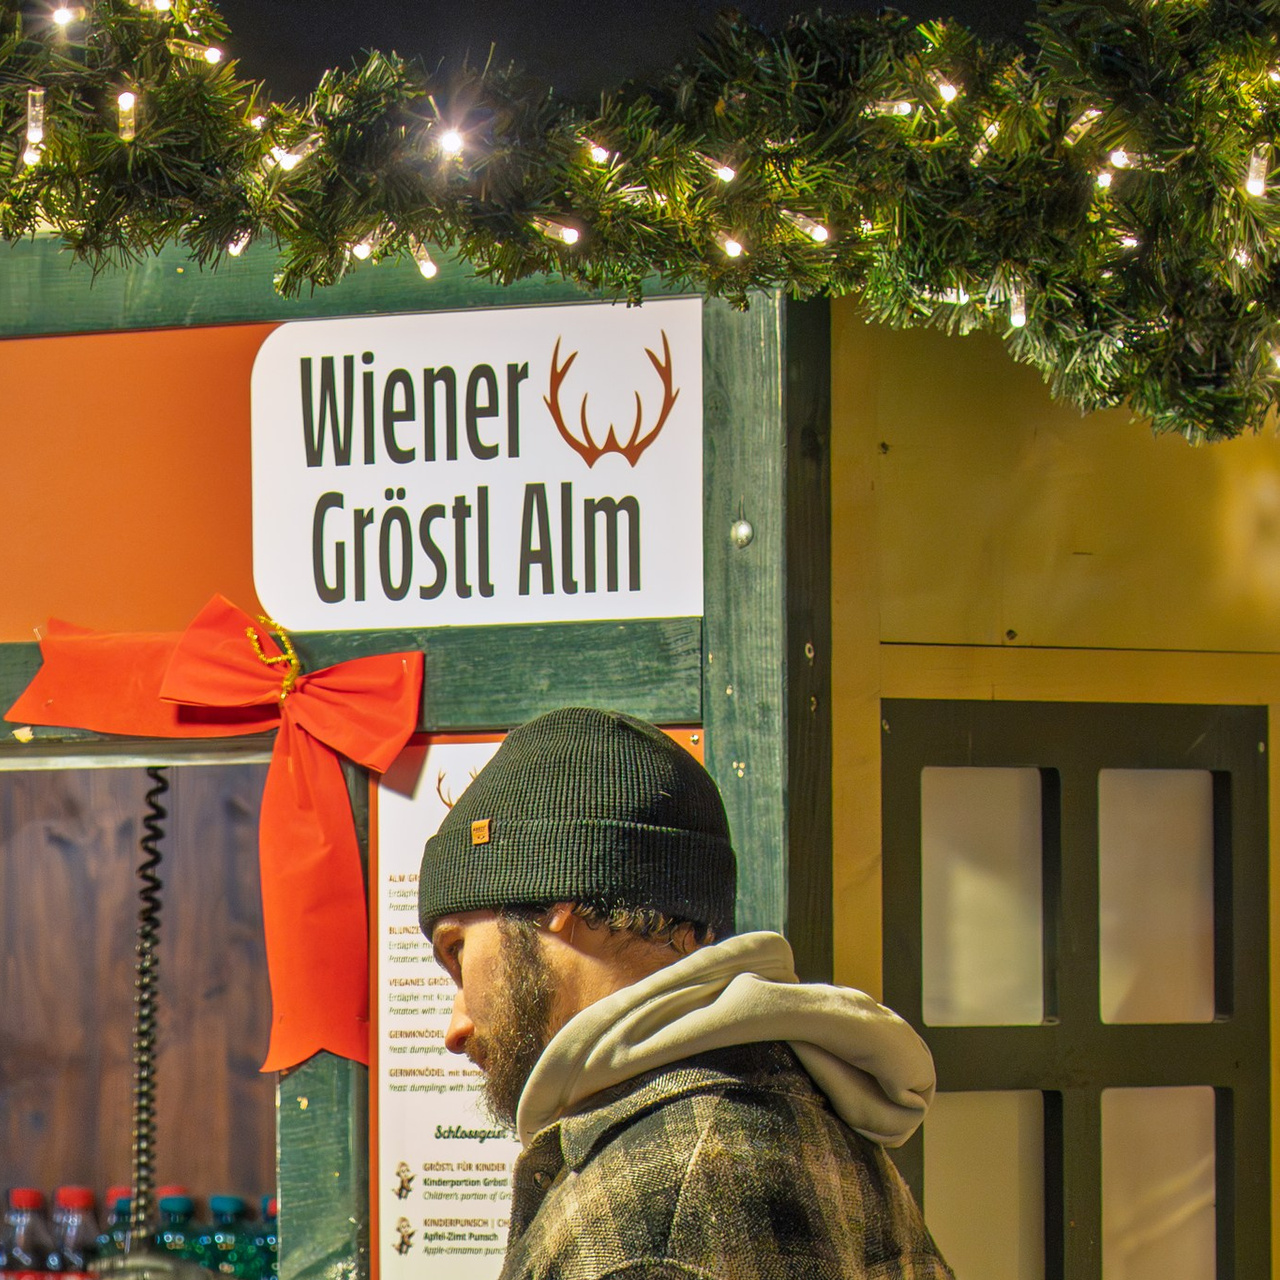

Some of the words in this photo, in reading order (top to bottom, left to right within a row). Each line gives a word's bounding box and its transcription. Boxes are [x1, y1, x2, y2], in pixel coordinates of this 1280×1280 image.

[300, 351, 529, 467] Wiener
[312, 485, 495, 604] Gröstl
[518, 481, 641, 596] Alm
[388, 926, 421, 935] BLUNZE
[389, 1029, 445, 1039] GERMKNÖDEL
[389, 1067, 445, 1077] GERMKNÖDEL
[423, 1162, 455, 1172] GRÖSTL
[457, 1161, 474, 1172] FÜR
[475, 1163, 507, 1172] KINDER
[423, 1178, 481, 1188] Kinderportion
[460, 1192, 488, 1202] portion
[423, 1218, 489, 1228] KINDERPUNSCH
[423, 1232, 467, 1242] Apfel-Zimt
[468, 1232, 499, 1241] Punsch
